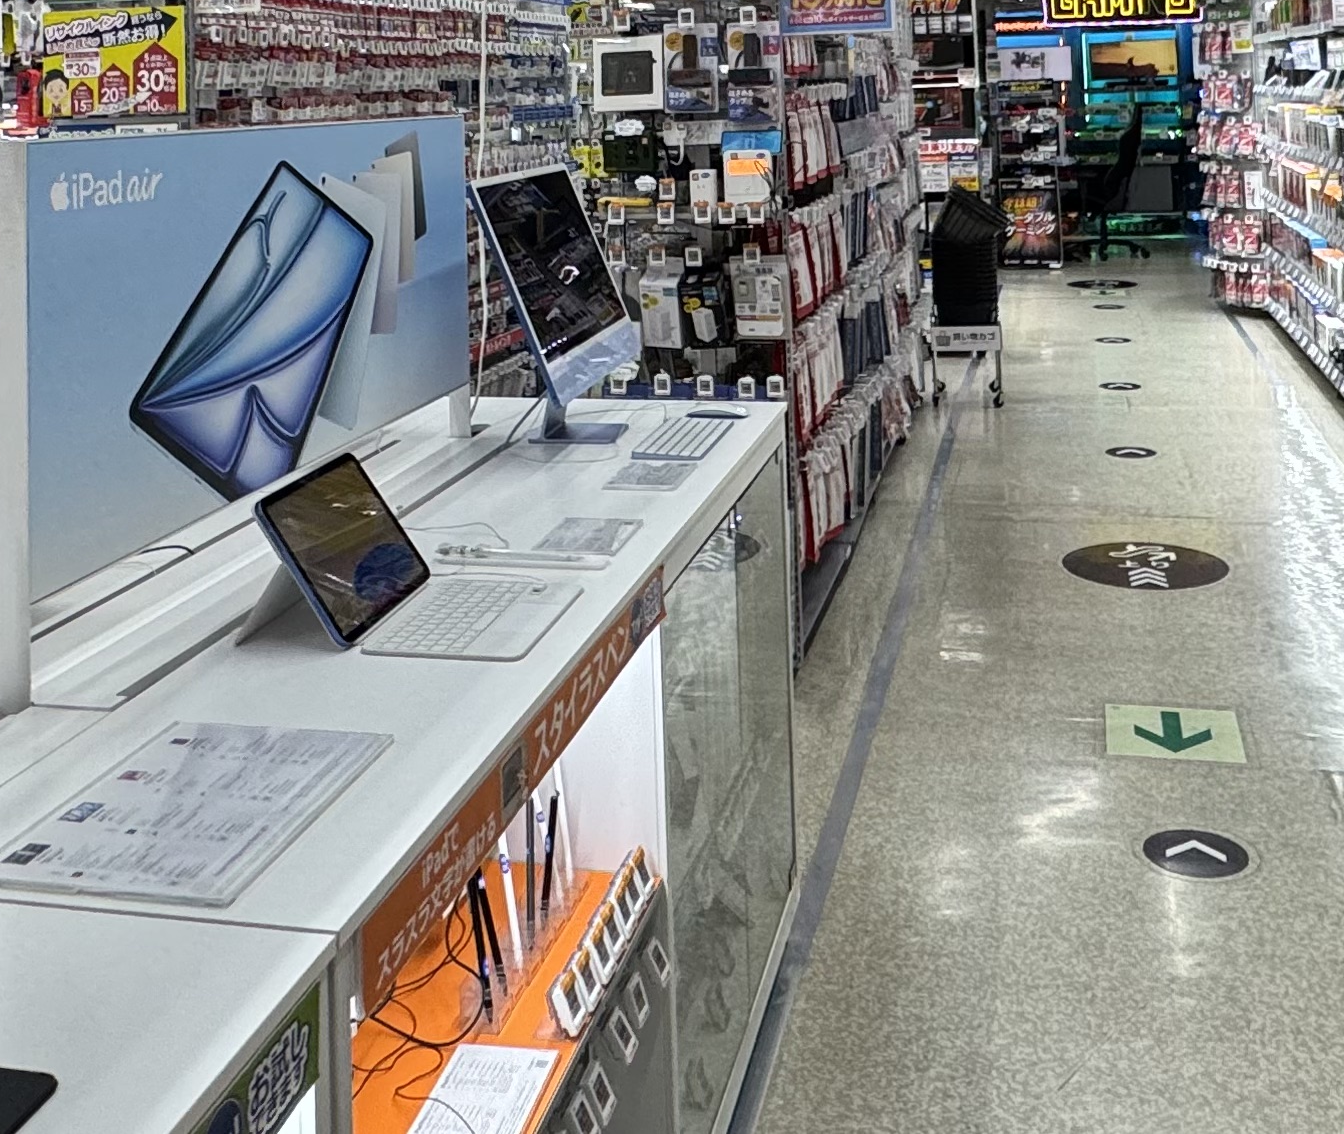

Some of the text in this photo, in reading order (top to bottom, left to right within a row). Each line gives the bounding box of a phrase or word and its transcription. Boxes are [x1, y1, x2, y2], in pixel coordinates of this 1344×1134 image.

[72, 170, 164, 210] iPad air
[533, 626, 630, 776] スタイラスペン
[423, 823, 460, 888] iPadで
